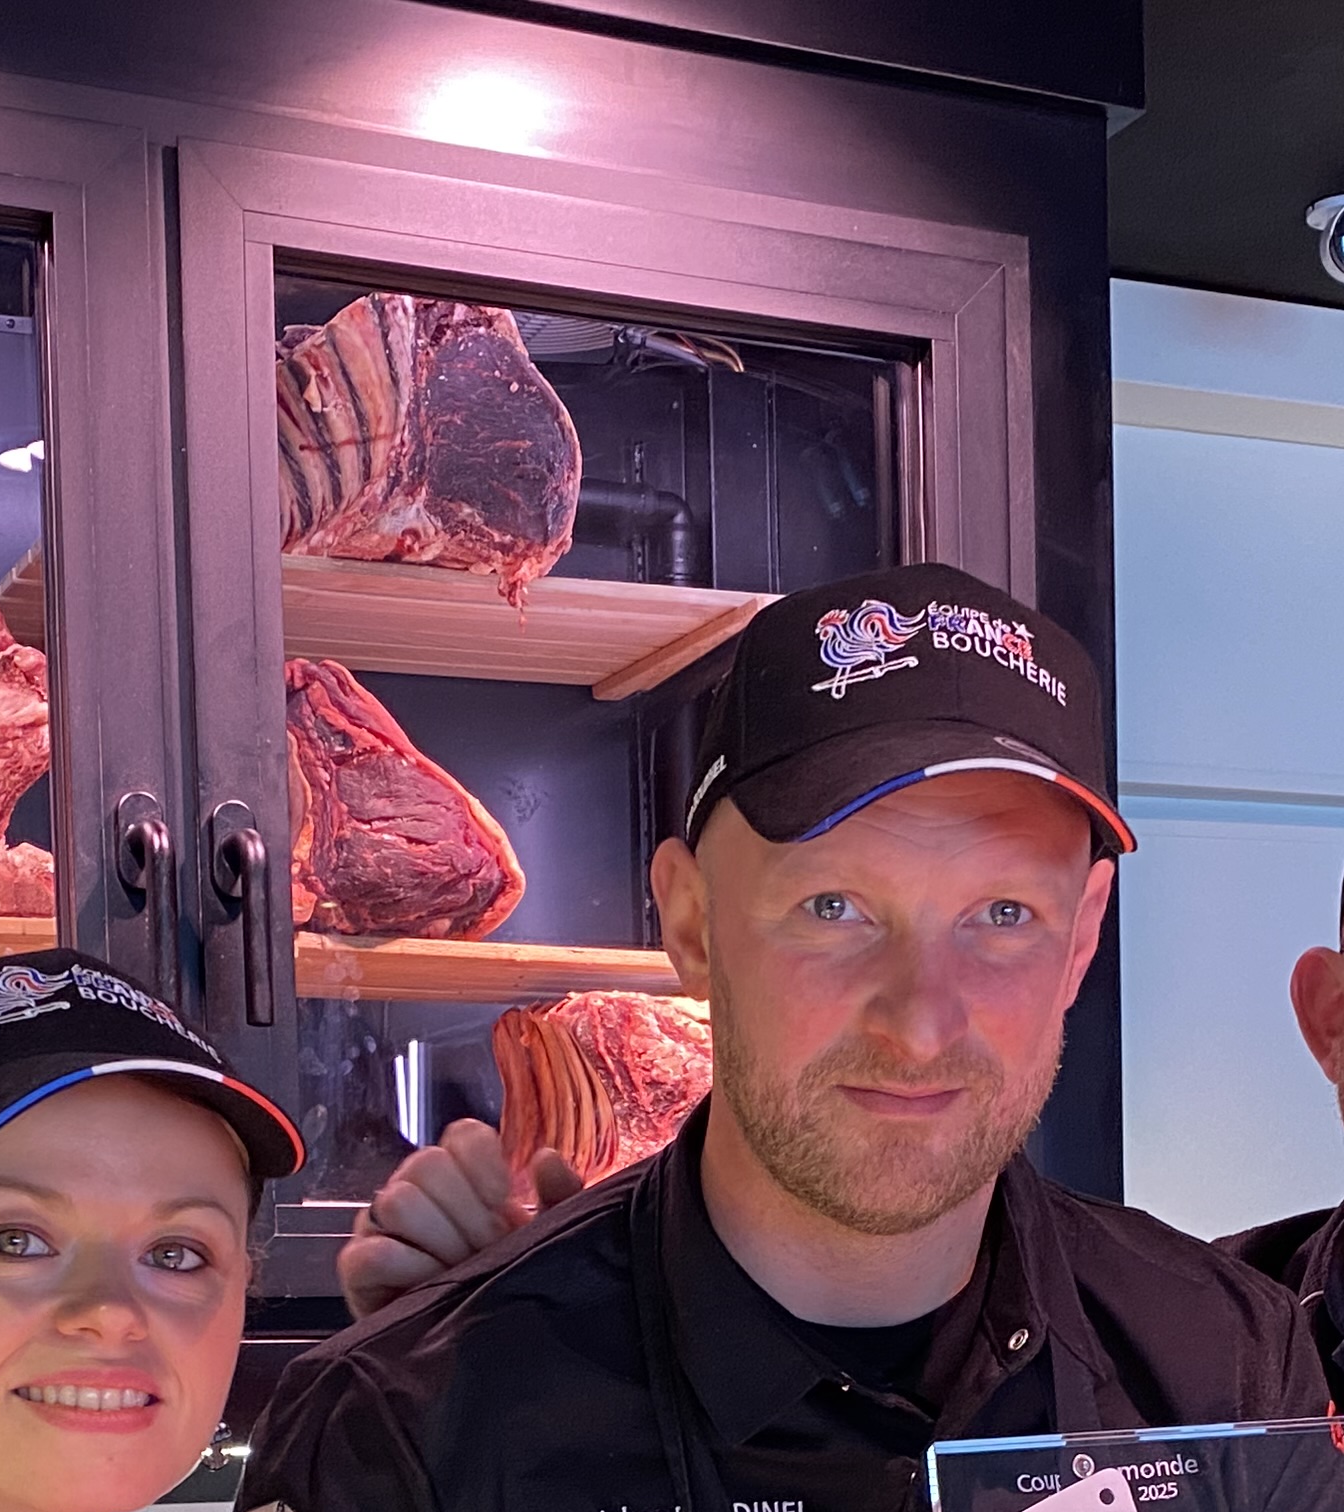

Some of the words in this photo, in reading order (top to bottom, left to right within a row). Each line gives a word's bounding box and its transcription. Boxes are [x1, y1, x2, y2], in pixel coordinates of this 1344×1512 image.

[932, 631, 1067, 706] BOUCHERIE
[1117, 1454, 1199, 1481] monde
[1138, 1482, 1178, 1501] 2025
